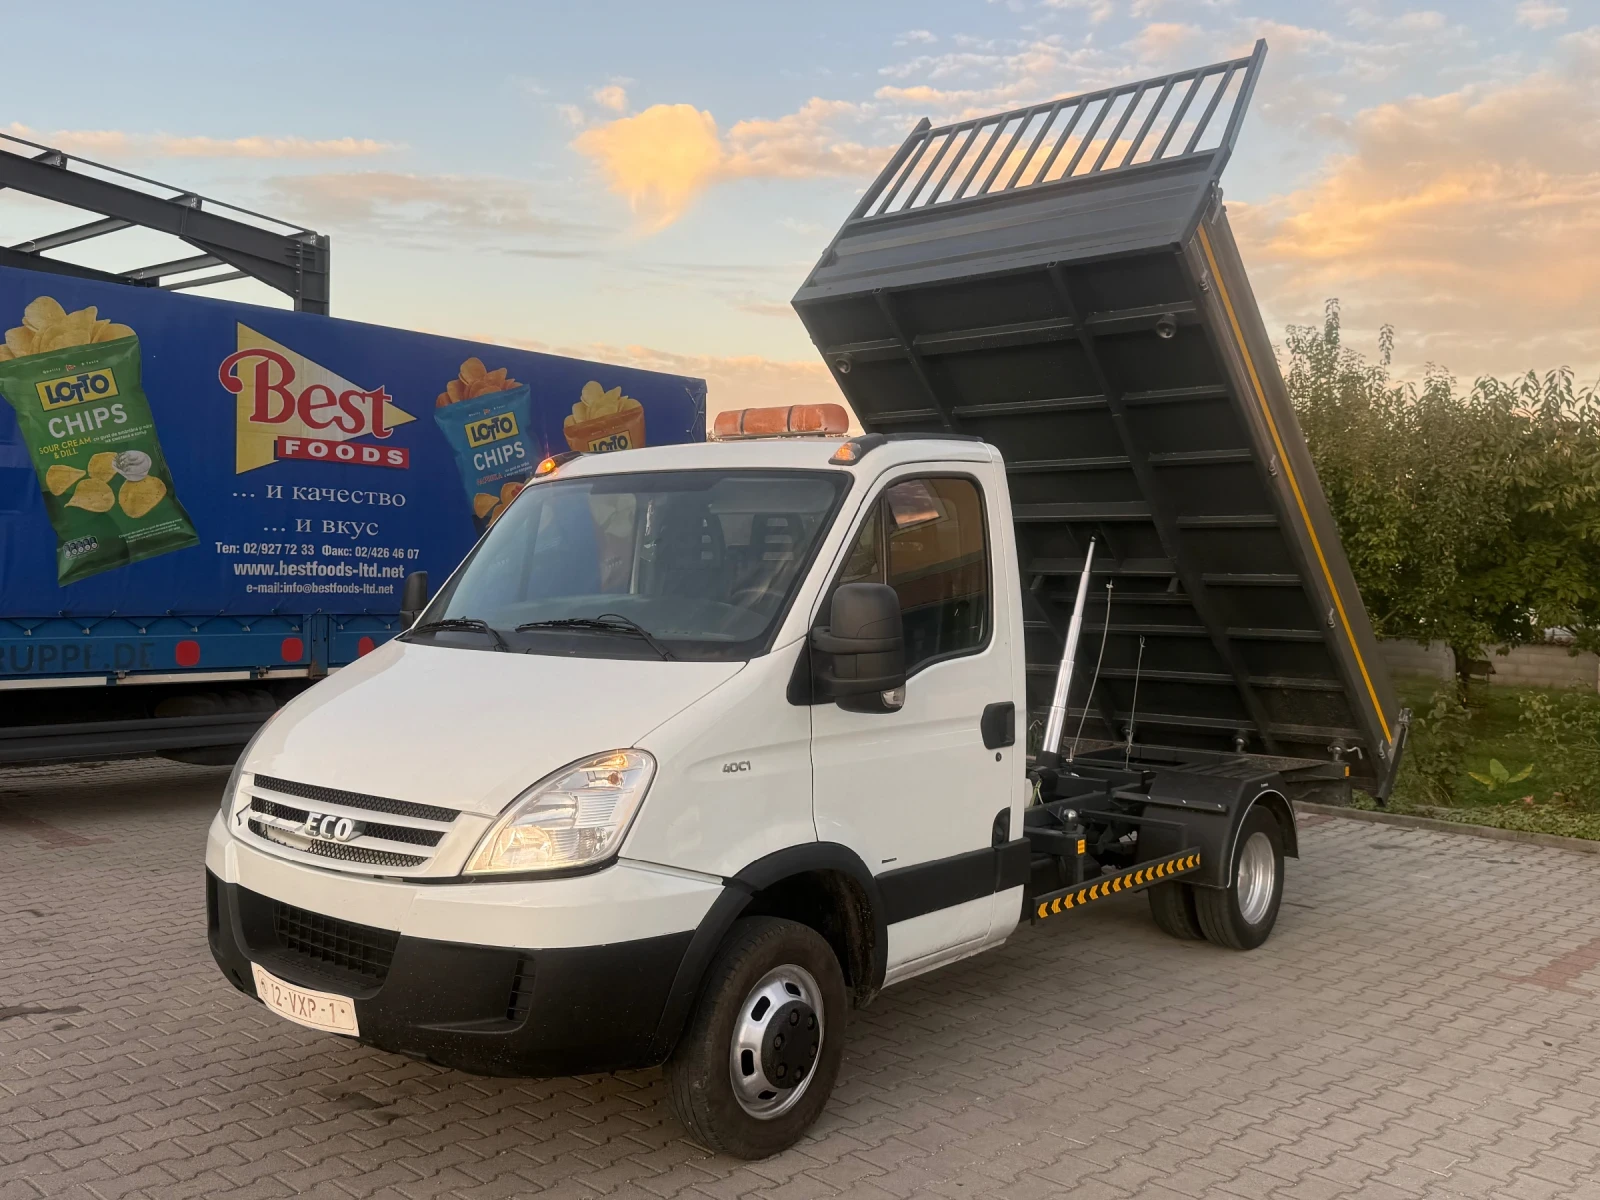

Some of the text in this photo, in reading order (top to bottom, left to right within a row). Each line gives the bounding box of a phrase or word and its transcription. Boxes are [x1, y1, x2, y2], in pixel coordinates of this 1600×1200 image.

[45, 374, 110, 404] LOTTO
[219, 348, 393, 439] Best
[48, 403, 128, 439] CHIPS
[471, 417, 513, 442] LOTTO
[39, 437, 92, 454] SOUR CREAM
[54, 448, 78, 459] & DILL
[285, 440, 404, 465] FOODS
[473, 441, 525, 471] CHIPS
[265, 484, 283, 499] и
[291, 486, 406, 507] качество
[295, 519, 312, 532] и
[321, 520, 379, 540] вкус
[215, 541, 420, 559] Тел: 02/927 72 33 Факс: 02/426 46 07
[233, 560, 404, 578] www.bestfoods-ltd.net
[246, 582, 394, 594] e-mail:info@bestfoods-ltd.net
[304, 811, 354, 842] ECO
